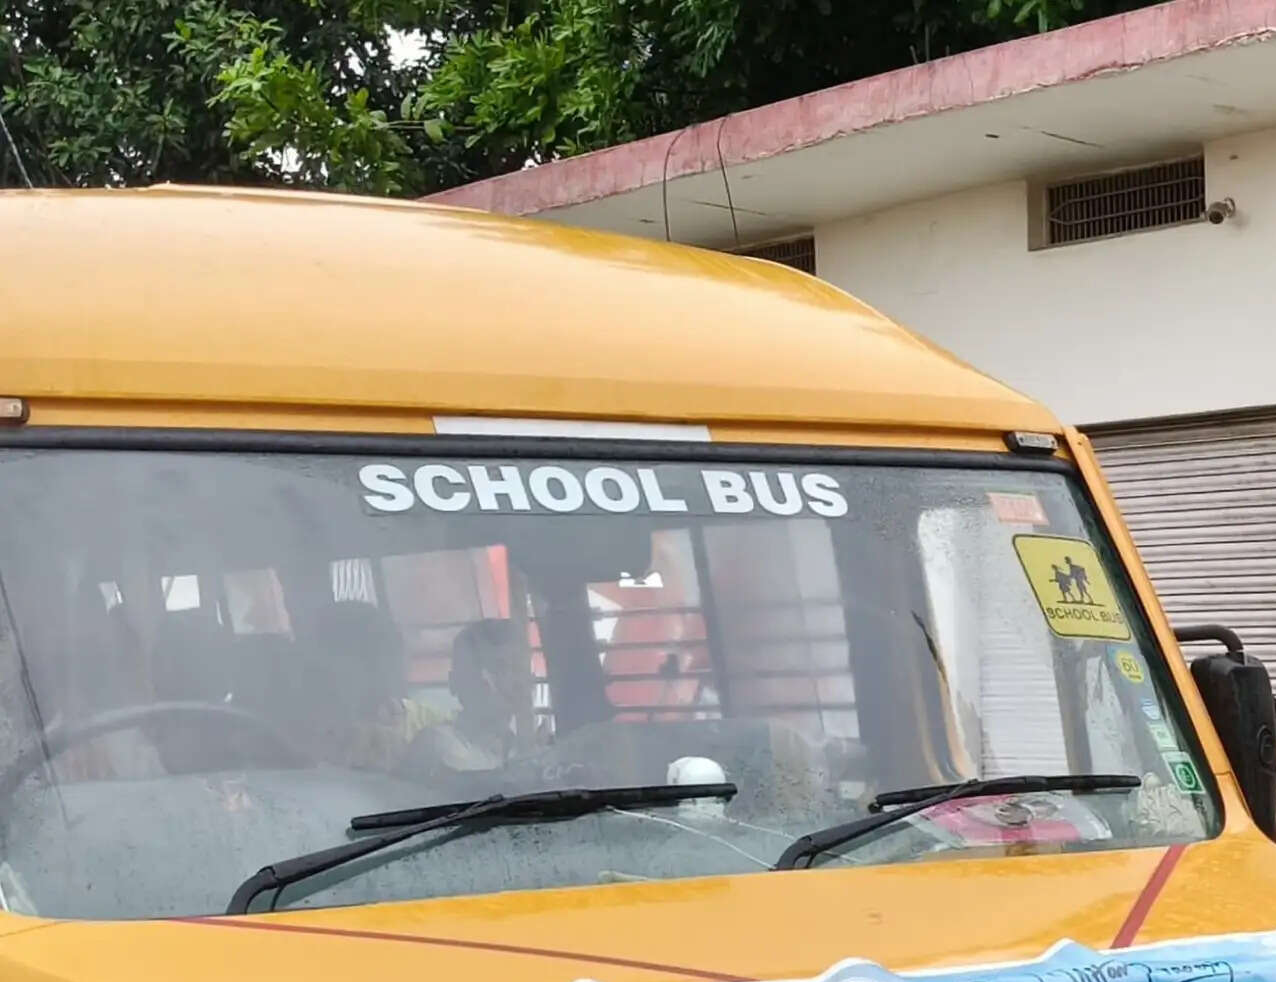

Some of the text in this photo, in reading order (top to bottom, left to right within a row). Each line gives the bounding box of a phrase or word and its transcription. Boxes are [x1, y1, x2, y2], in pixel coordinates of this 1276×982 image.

[358, 463, 849, 518] SCHOOL BUS
[1046, 607, 1124, 624] SCHOOL BUS
